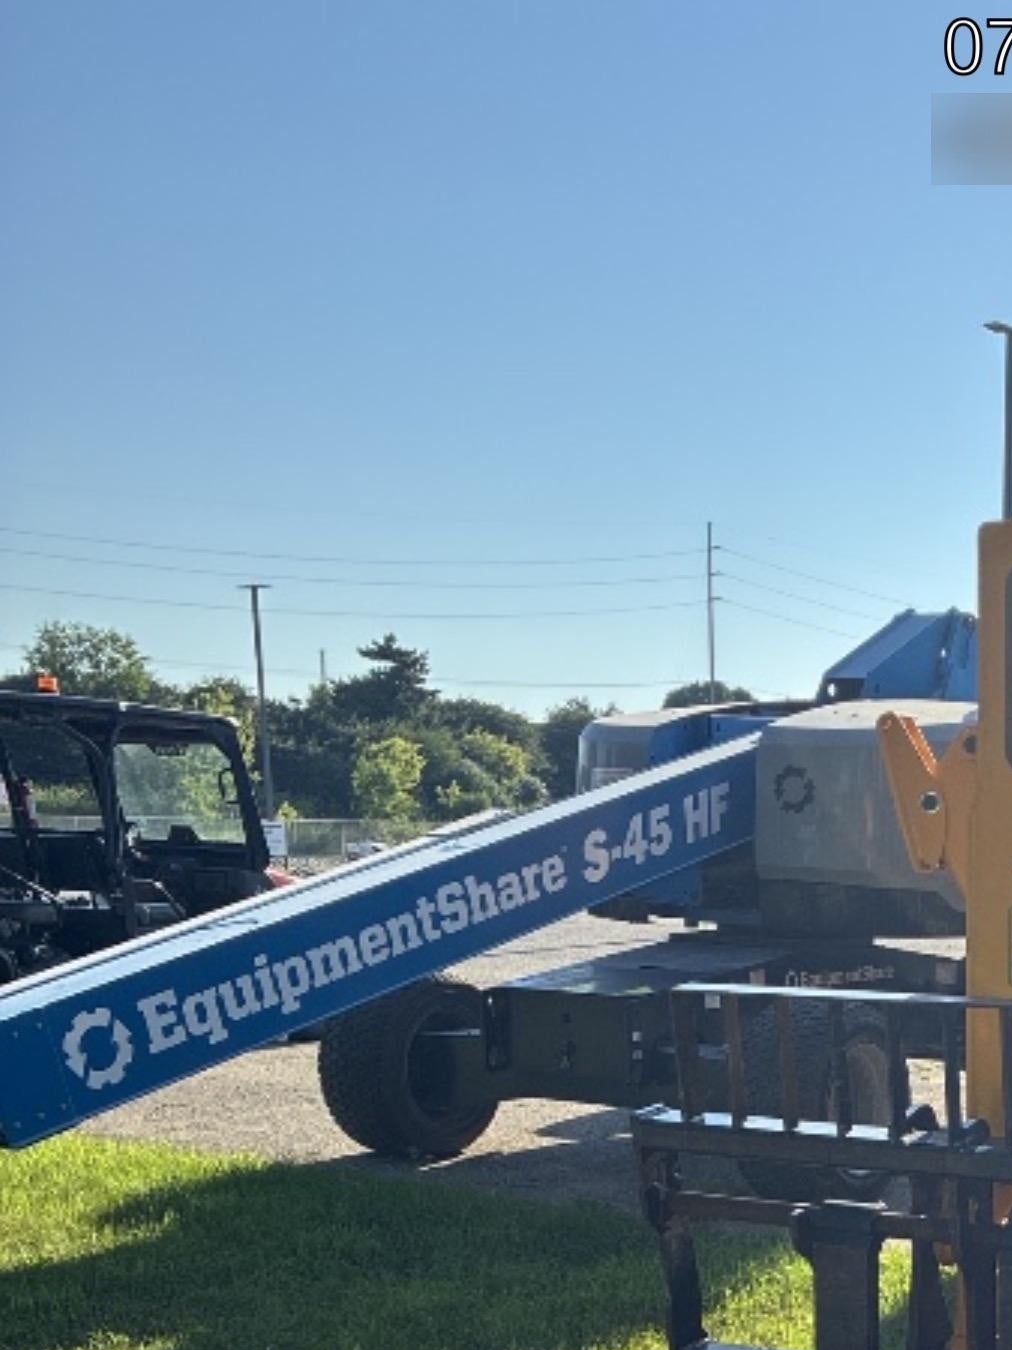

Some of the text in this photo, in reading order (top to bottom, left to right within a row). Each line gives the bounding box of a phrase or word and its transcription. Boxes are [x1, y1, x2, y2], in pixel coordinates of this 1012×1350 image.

[137, 781, 729, 1054] EquipmentShare S-45 HF
